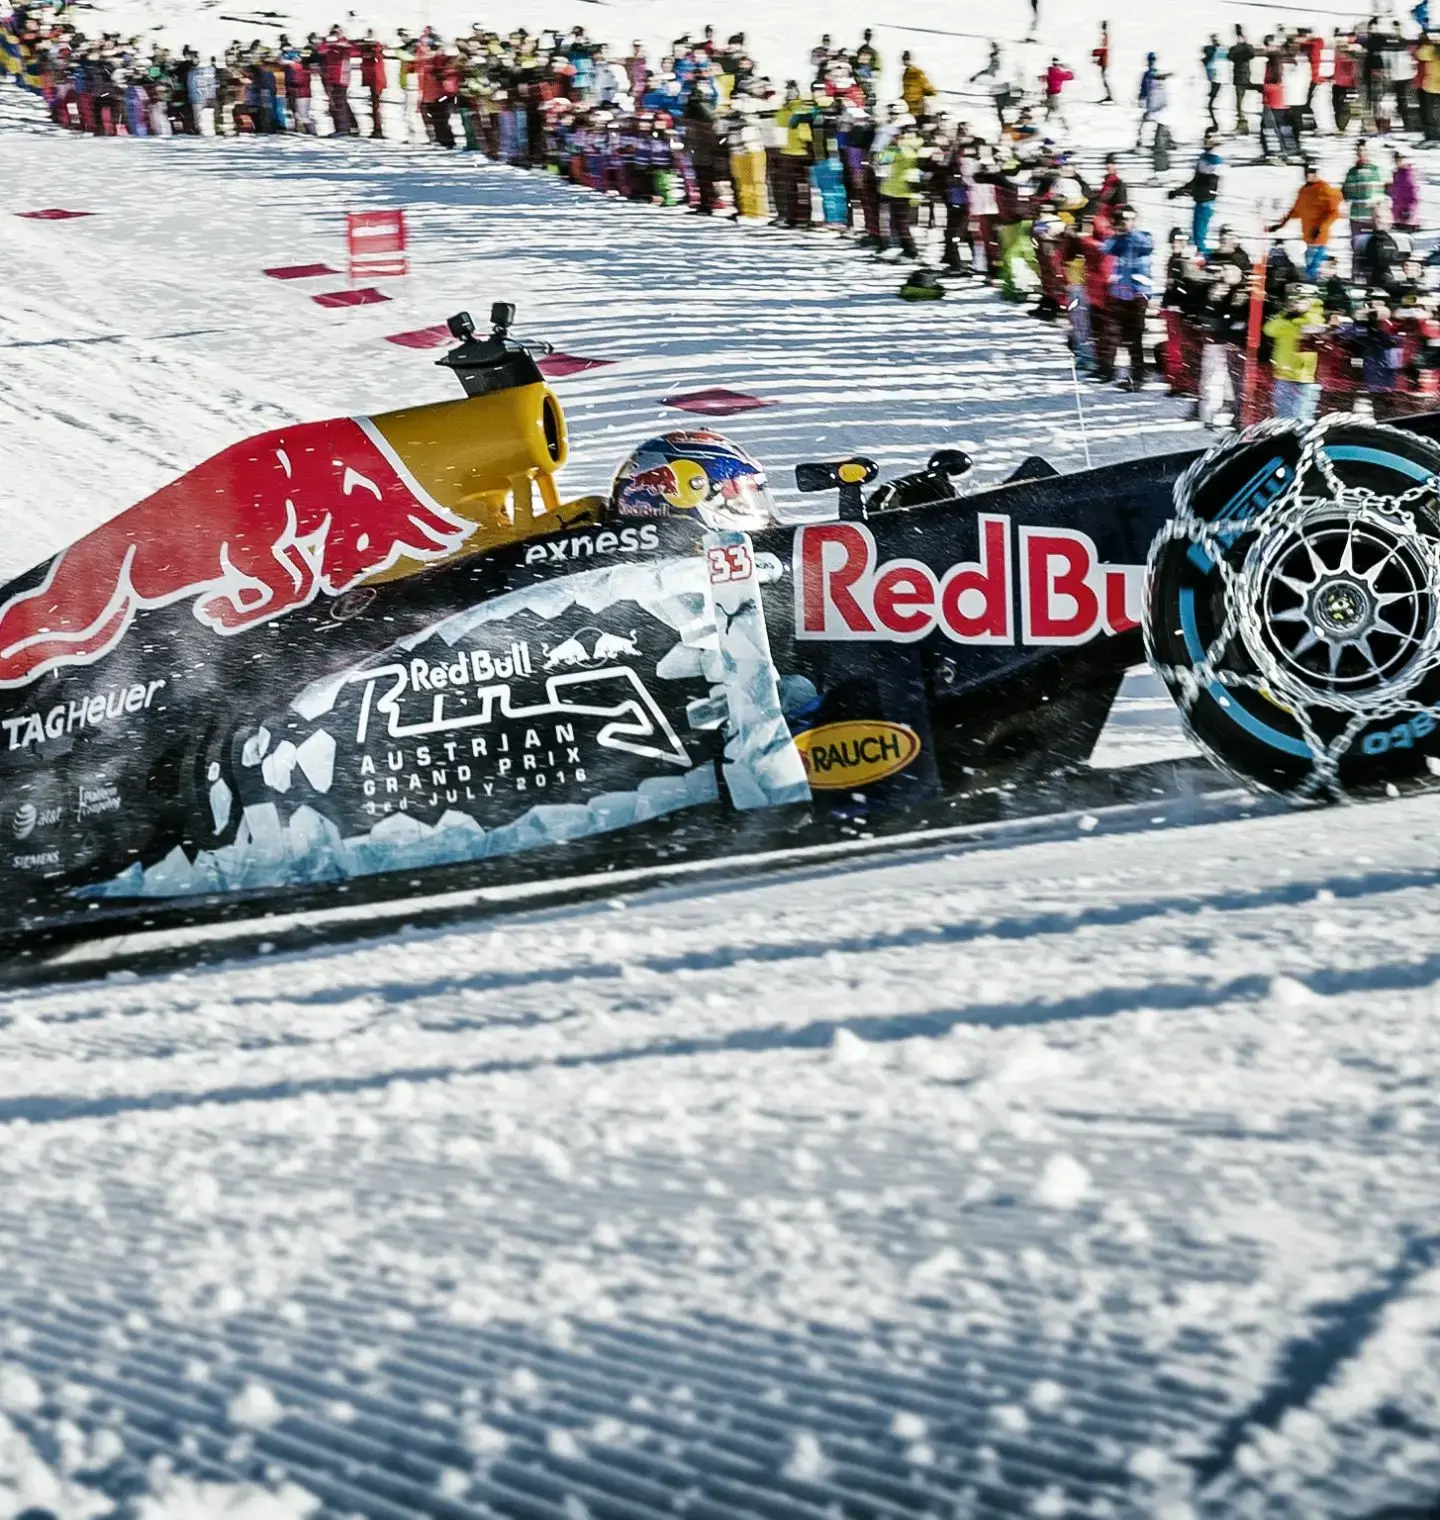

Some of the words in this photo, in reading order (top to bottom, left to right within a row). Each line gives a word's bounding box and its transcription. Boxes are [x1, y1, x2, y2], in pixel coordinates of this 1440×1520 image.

[525, 524, 660, 565] exness
[708, 545, 753, 585] 33
[1026, 535, 1144, 638] Bu
[361, 723, 575, 775] AUSTRIAN
[811, 733, 901, 773] RAUCH
[363, 765, 472, 797] GRAND
[499, 747, 580, 776] PRIX
[428, 782, 494, 807] JULY
[516, 768, 587, 792] 2016
